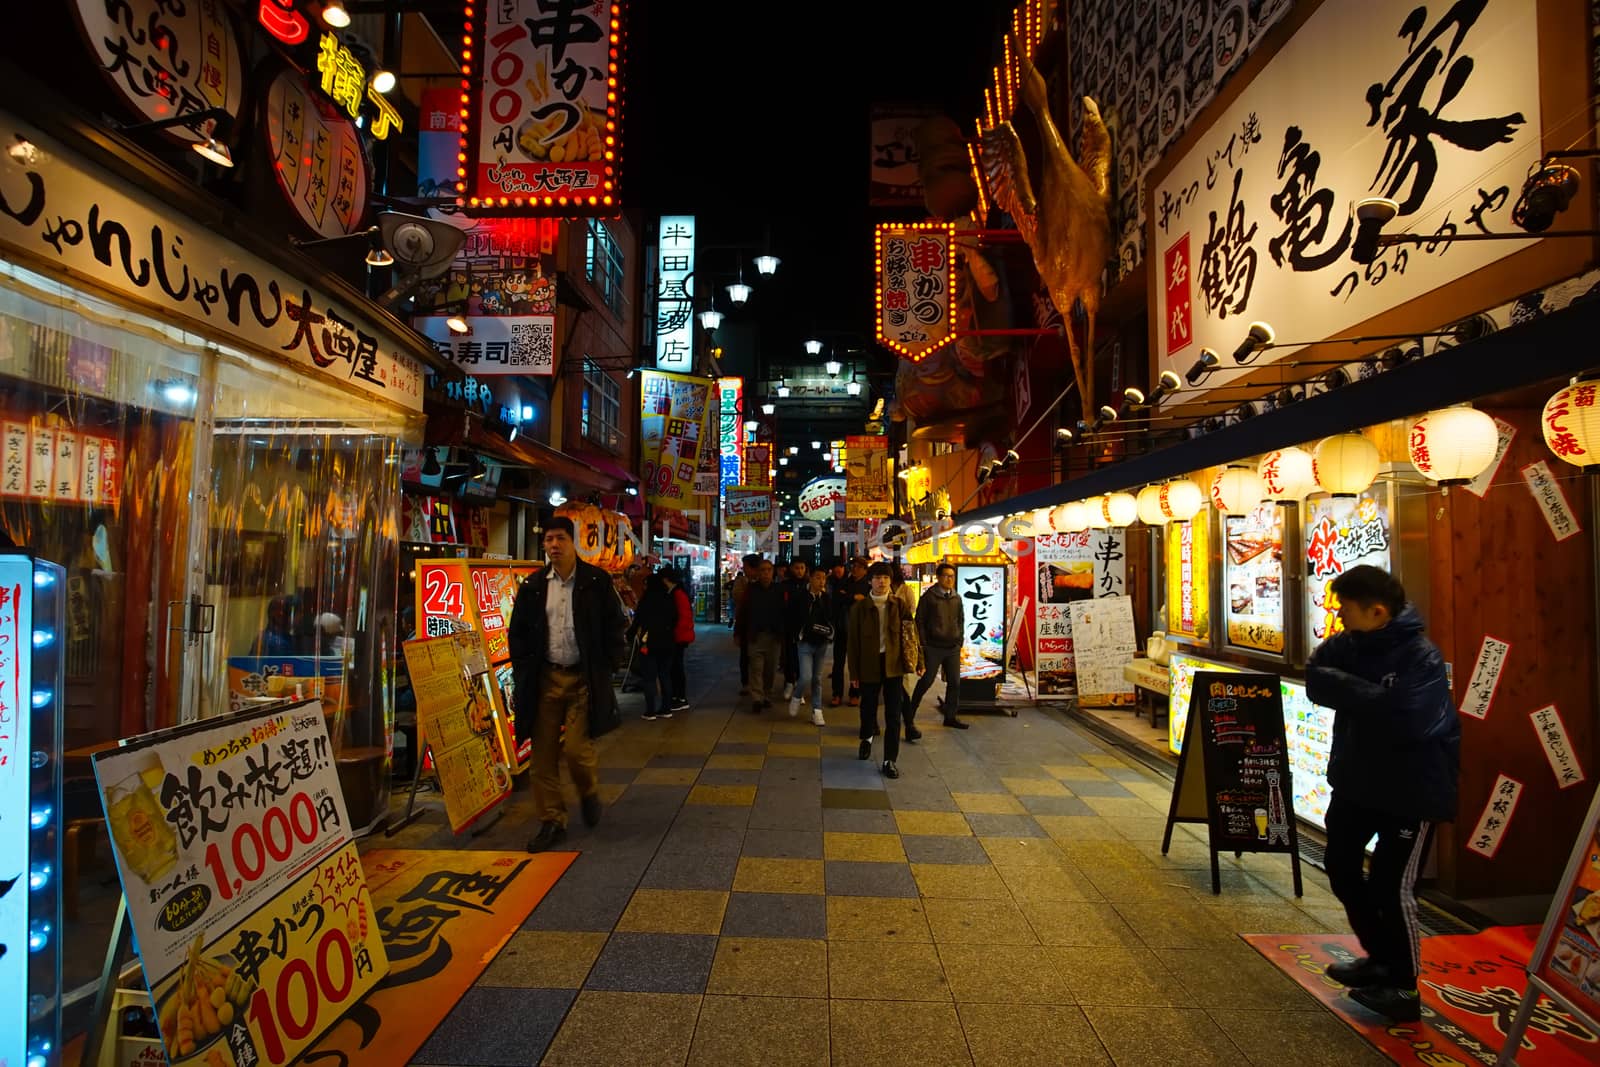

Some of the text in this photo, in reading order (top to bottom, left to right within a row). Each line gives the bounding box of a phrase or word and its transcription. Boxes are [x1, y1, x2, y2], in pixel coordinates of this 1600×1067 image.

[535, 168, 595, 190] 大西屋
[908, 237, 945, 325] 串かつ
[1169, 250, 1189, 342] 名代
[1263, 451, 1285, 495] ハイボール
[1307, 518, 1387, 577] 飲み放題
[963, 574, 994, 642] エビス
[324, 851, 358, 889] タイム
[334, 869, 361, 897] サービス
[233, 902, 327, 985] 串かつ
